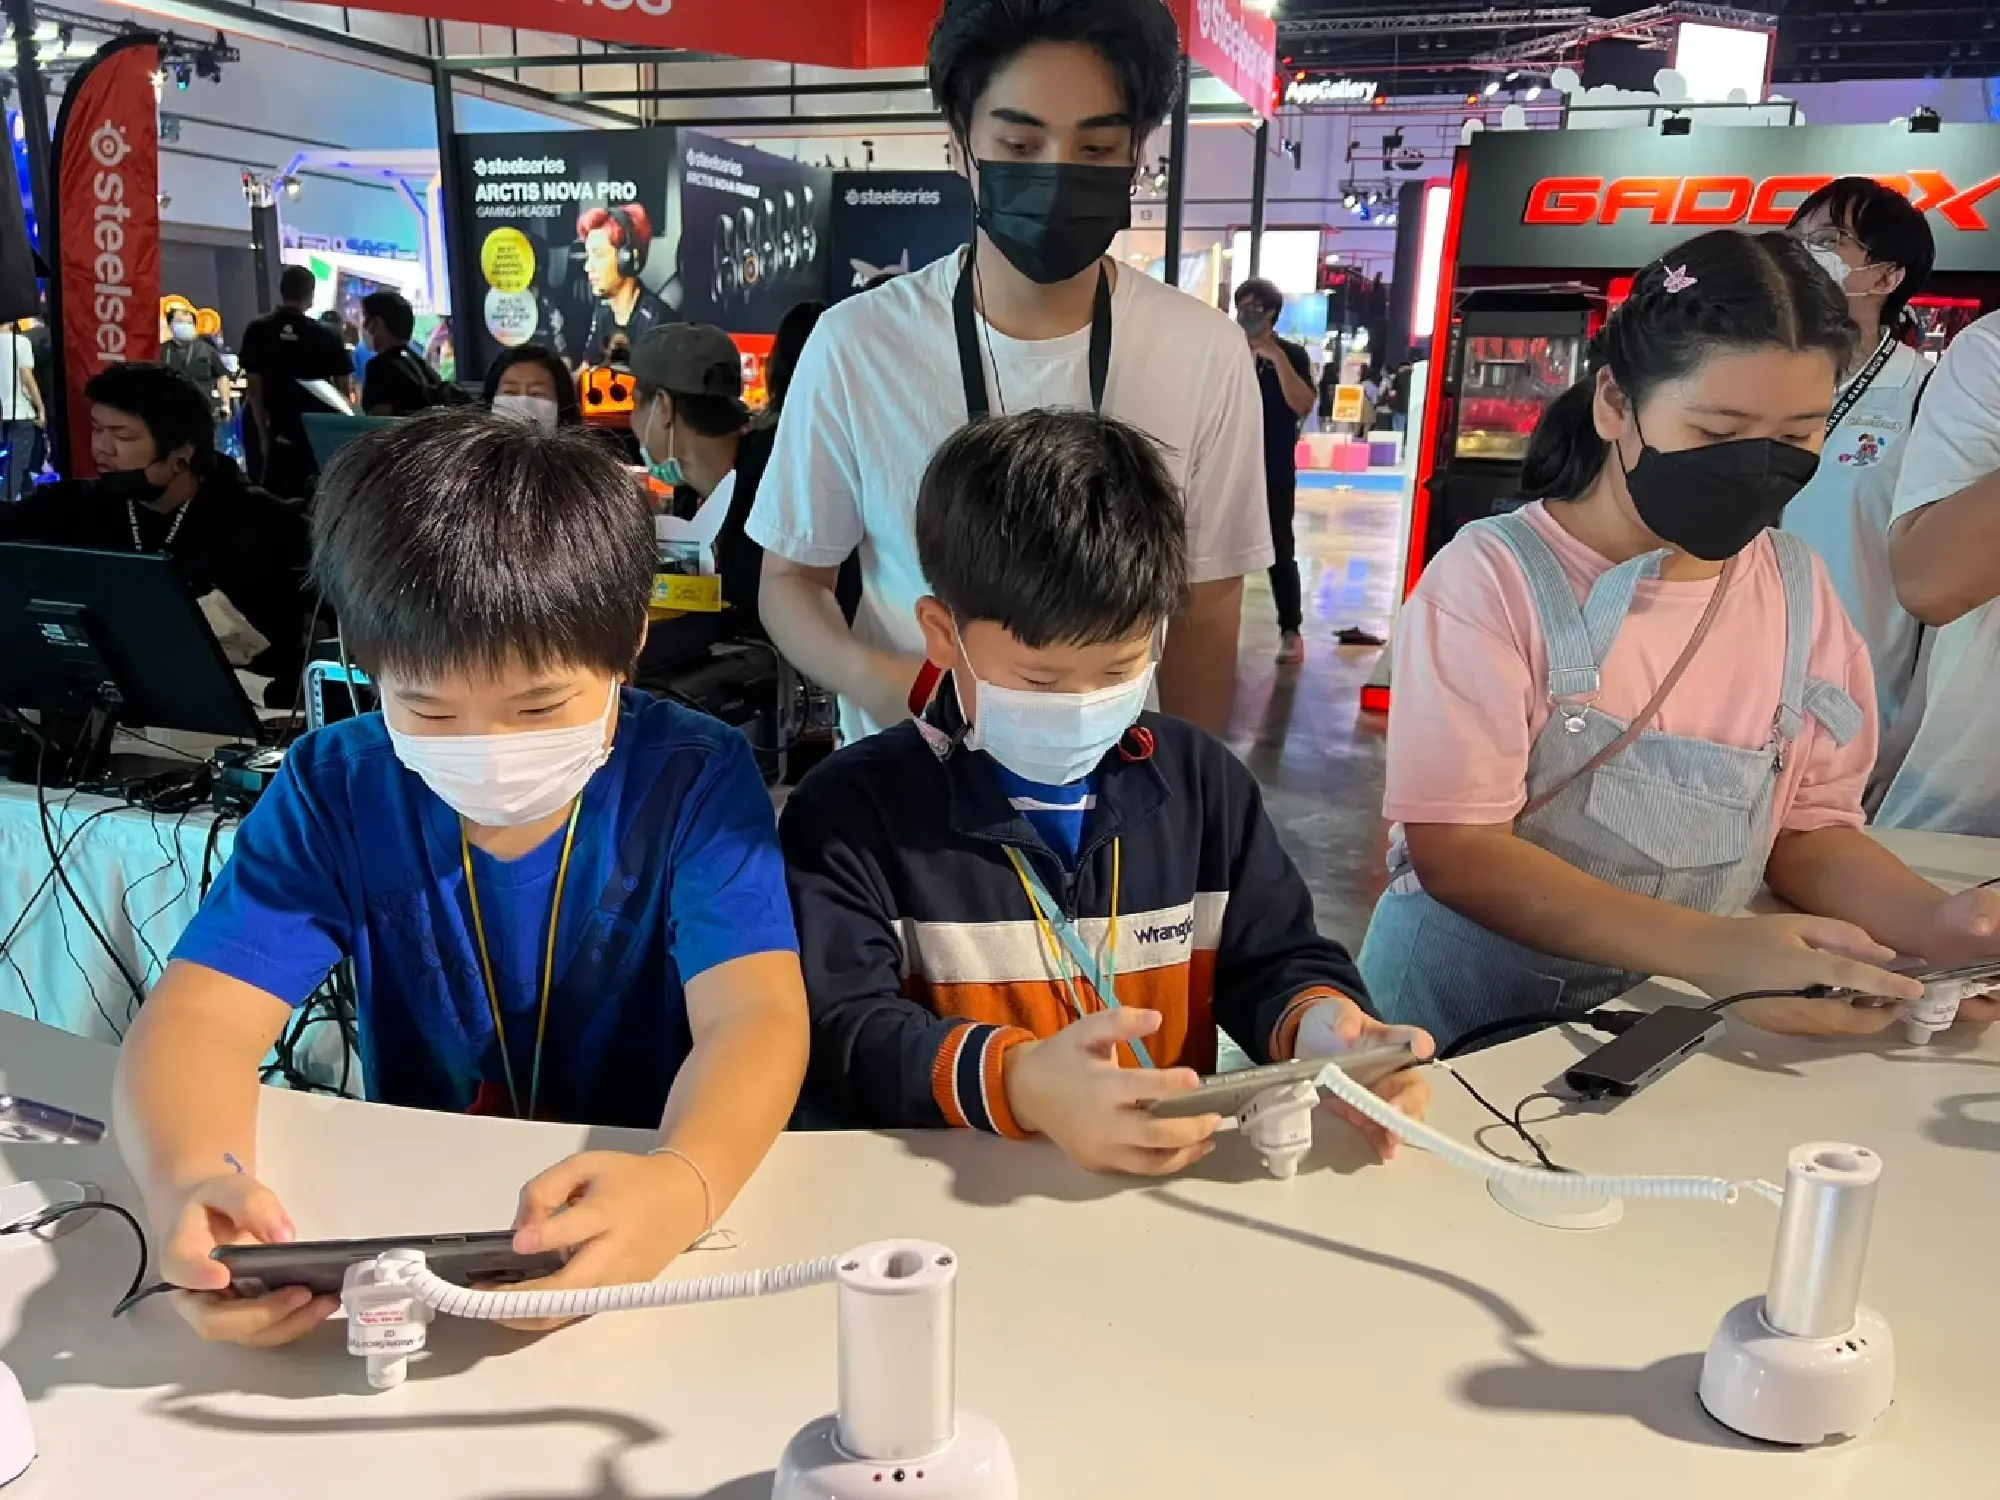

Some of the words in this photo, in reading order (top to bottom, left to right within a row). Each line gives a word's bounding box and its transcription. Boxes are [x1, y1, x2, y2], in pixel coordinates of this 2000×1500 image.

[1285, 79, 1378, 104] AppGallery
[487, 155, 567, 175] steelseries
[475, 181, 541, 202] ARCTIS
[543, 181, 594, 201] NOVA
[597, 181, 638, 200] PRO
[861, 187, 941, 205] steelseries
[476, 204, 516, 218] GAMING
[517, 204, 563, 218] HEADSET
